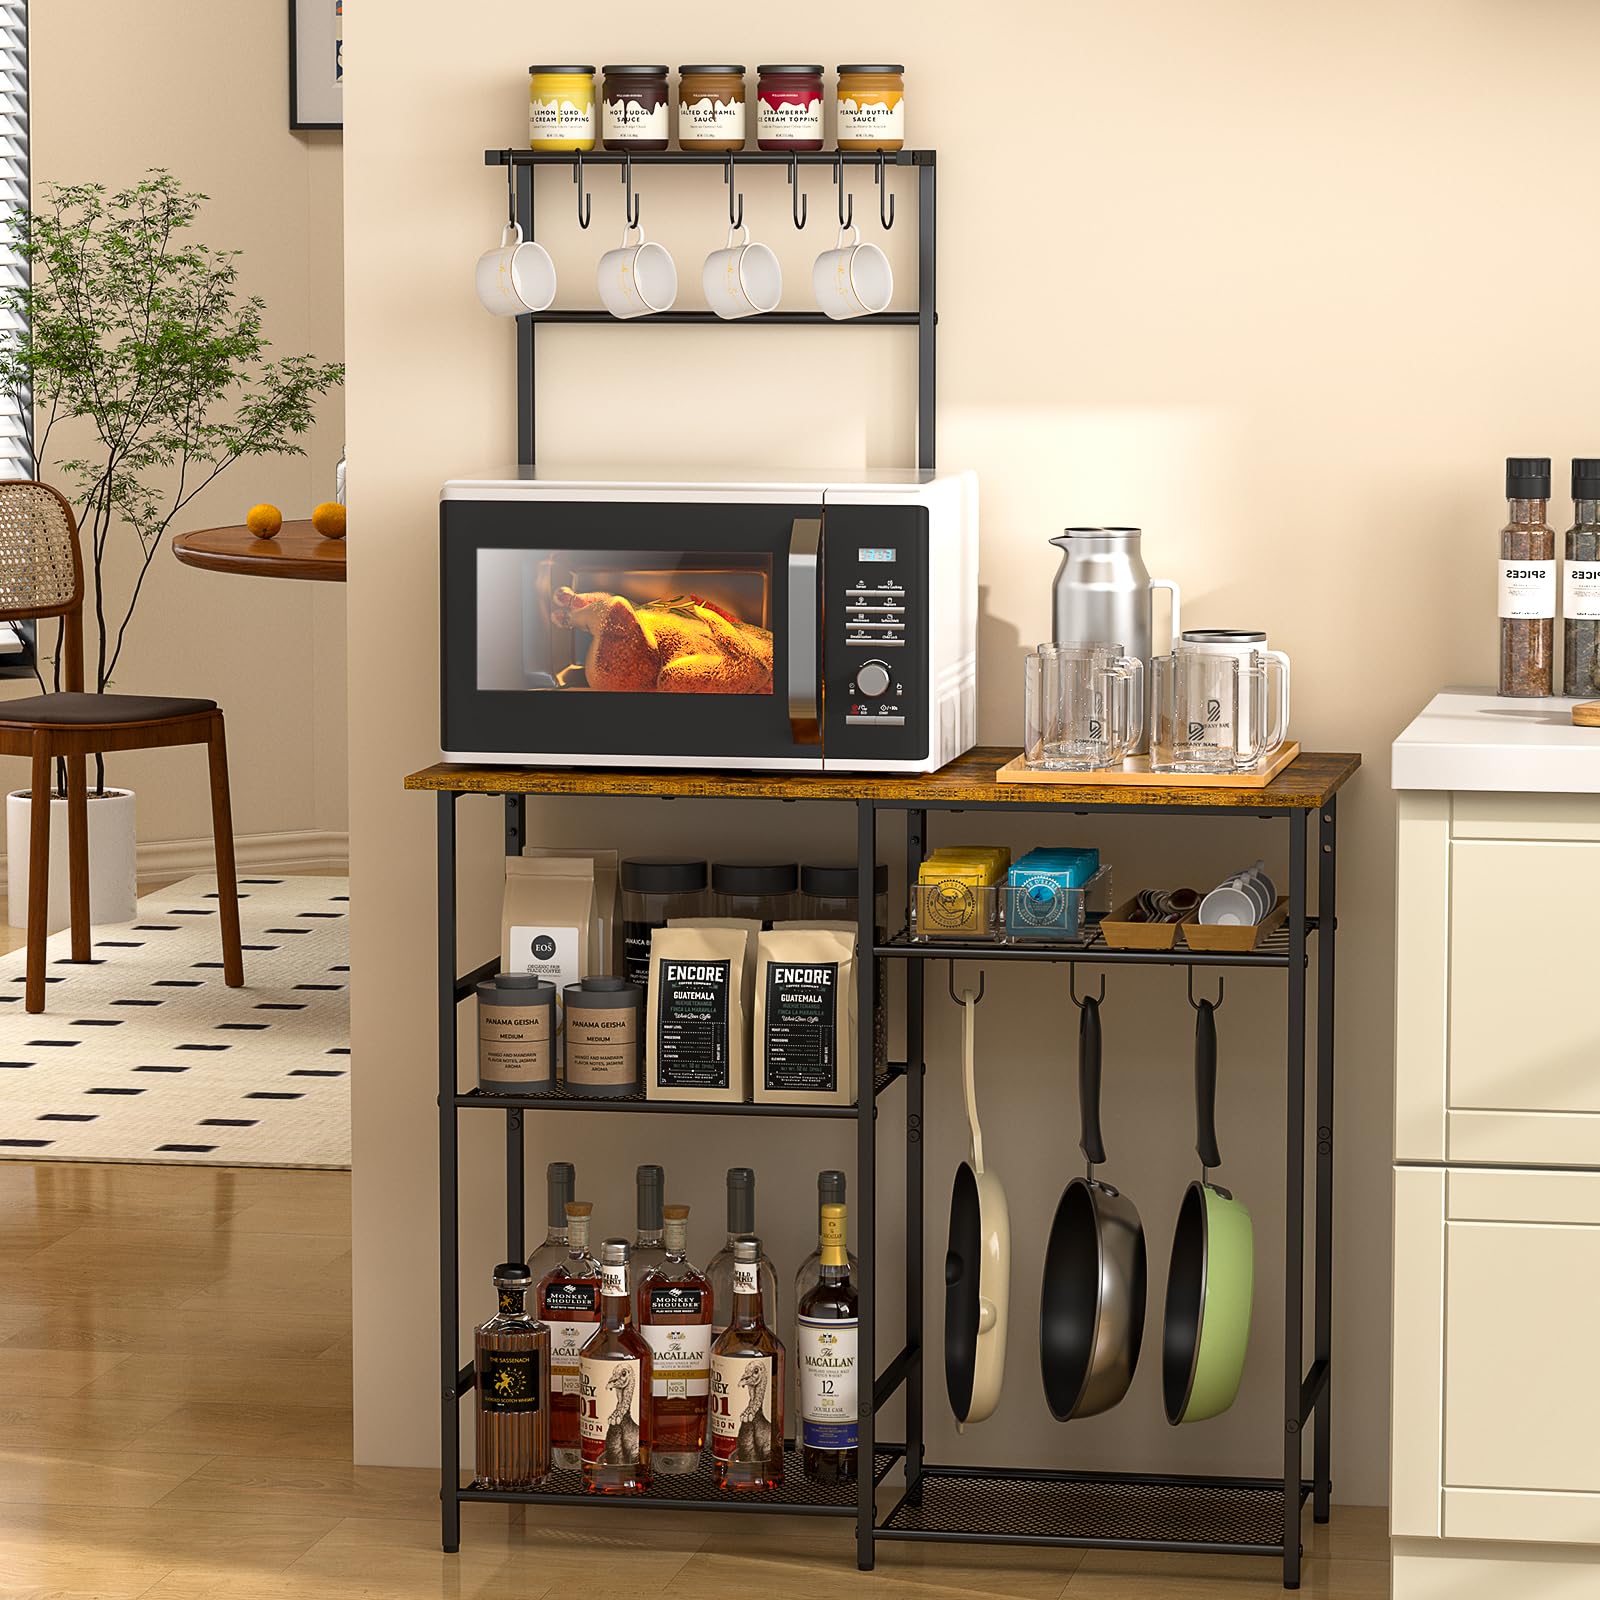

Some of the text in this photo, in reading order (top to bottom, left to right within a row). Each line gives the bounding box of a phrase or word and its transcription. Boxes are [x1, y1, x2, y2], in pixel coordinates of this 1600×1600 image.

[535, 944, 552, 952] EOS
[667, 965, 724, 982] ENCORE
[775, 968, 832, 985] ENCORE
[673, 991, 715, 1000] GUATEMALA
[781, 993, 823, 1003] GUATEMALA
[563, 1340, 576, 1348] The
[668, 1342, 681, 1351] The
[654, 1351, 704, 1360] MACALLAN
[820, 1348, 833, 1357] The
[805, 1355, 855, 1367] MACALLAN
[822, 1380, 834, 1394] 12
[581, 1396, 599, 1419] 01
[712, 1394, 731, 1417] 01
